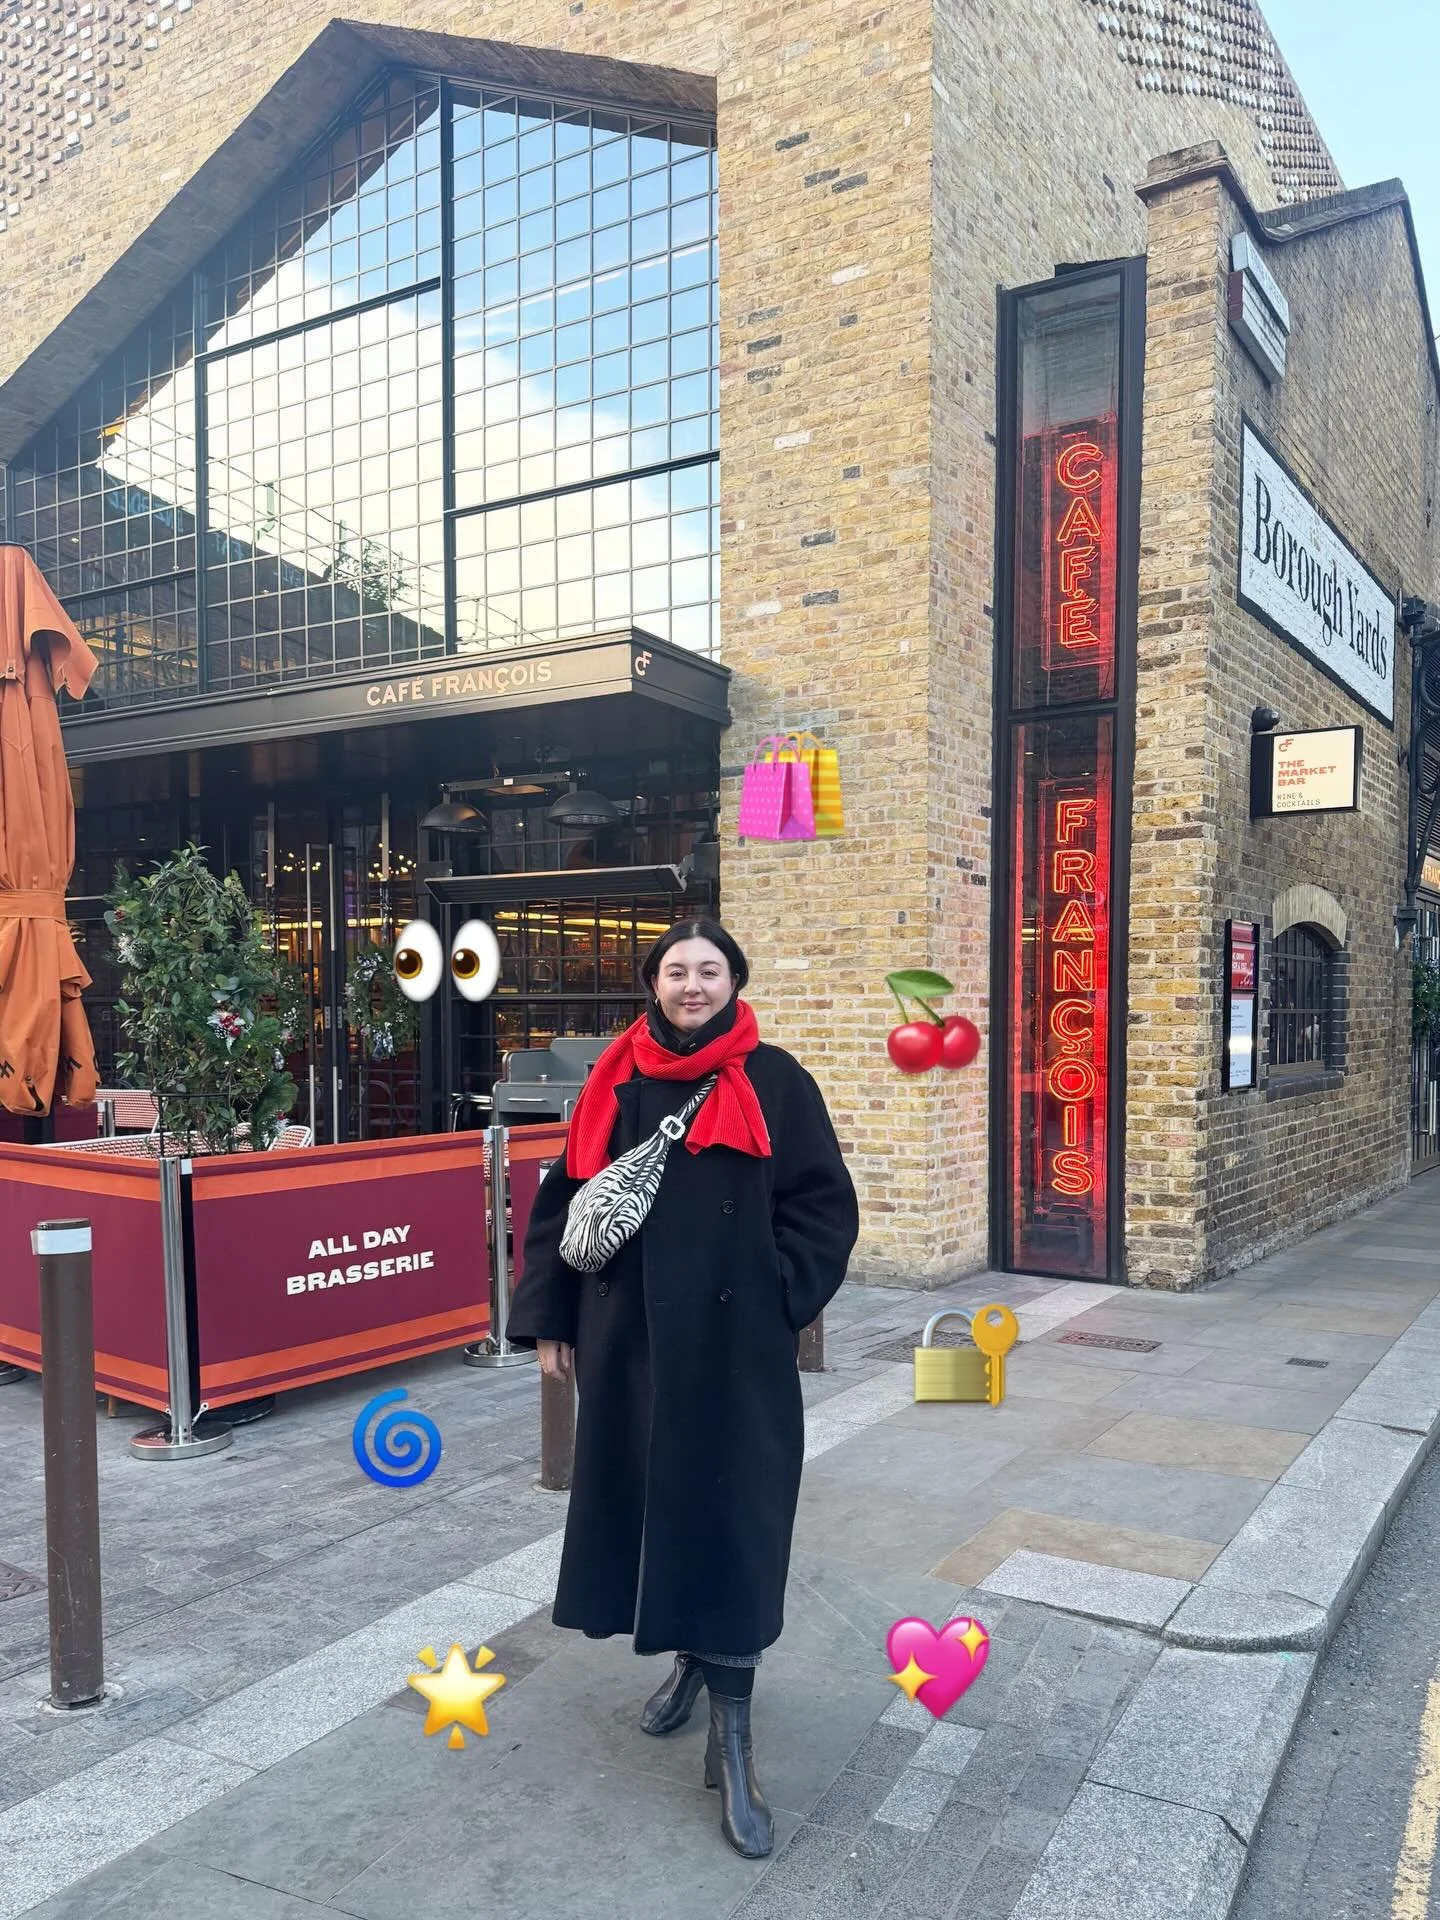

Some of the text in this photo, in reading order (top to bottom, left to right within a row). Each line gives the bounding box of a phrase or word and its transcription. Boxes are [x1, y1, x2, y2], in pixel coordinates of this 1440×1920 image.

[1057, 442, 1104, 648] CAFÉ
[1253, 471, 1388, 681] Borough Yards
[366, 661, 552, 706] CAFÉ FRANÇOIS
[1277, 777, 1306, 787] BAR
[1278, 760, 1305, 769] THE
[1278, 766, 1336, 778] MARKET
[1277, 793, 1296, 801] WINE
[1277, 799, 1321, 808] COCKTAILS
[1048, 799, 1099, 1195] FRANÇOIS
[308, 1224, 411, 1260] ALL DAY
[286, 1250, 434, 1296] BRASSERIE
